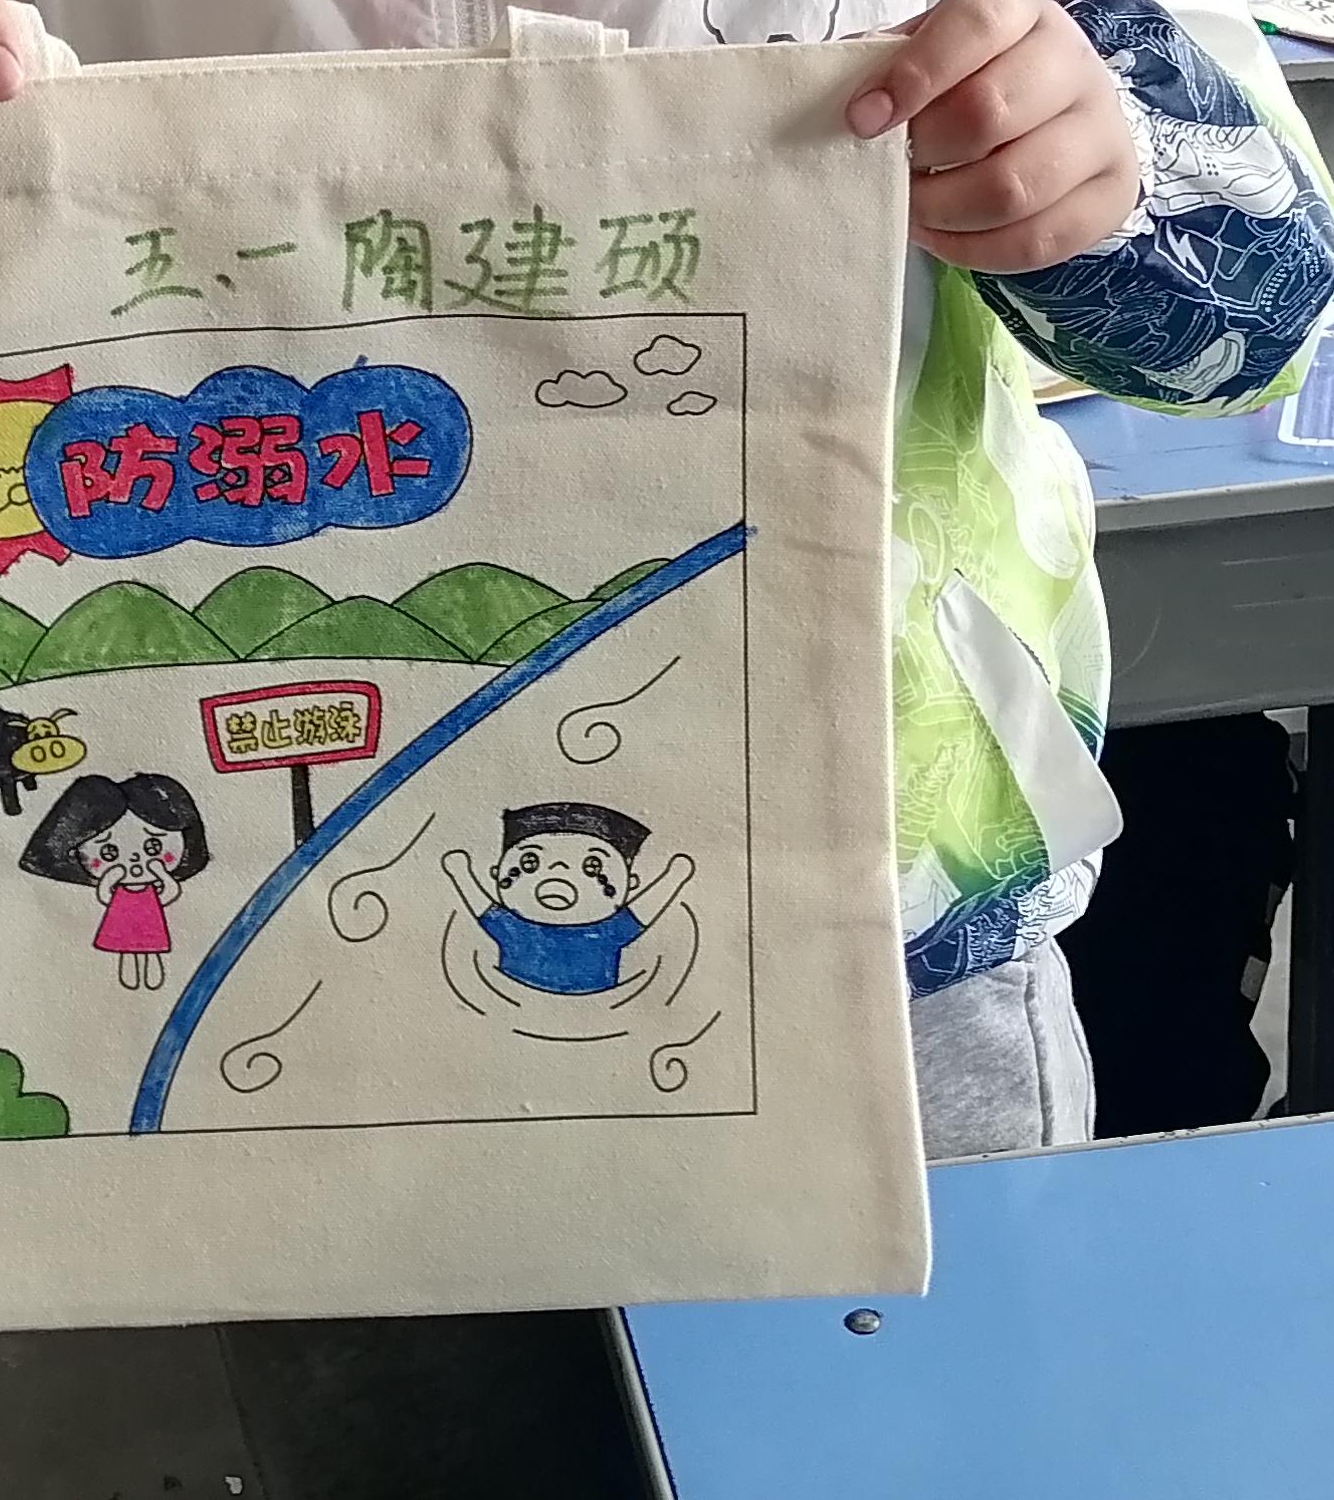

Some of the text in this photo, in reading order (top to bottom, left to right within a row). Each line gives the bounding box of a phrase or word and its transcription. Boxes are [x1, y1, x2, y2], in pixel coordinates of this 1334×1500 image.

[61, 409, 431, 518] 防溺水
[225, 700, 362, 755] 禁止游泳
